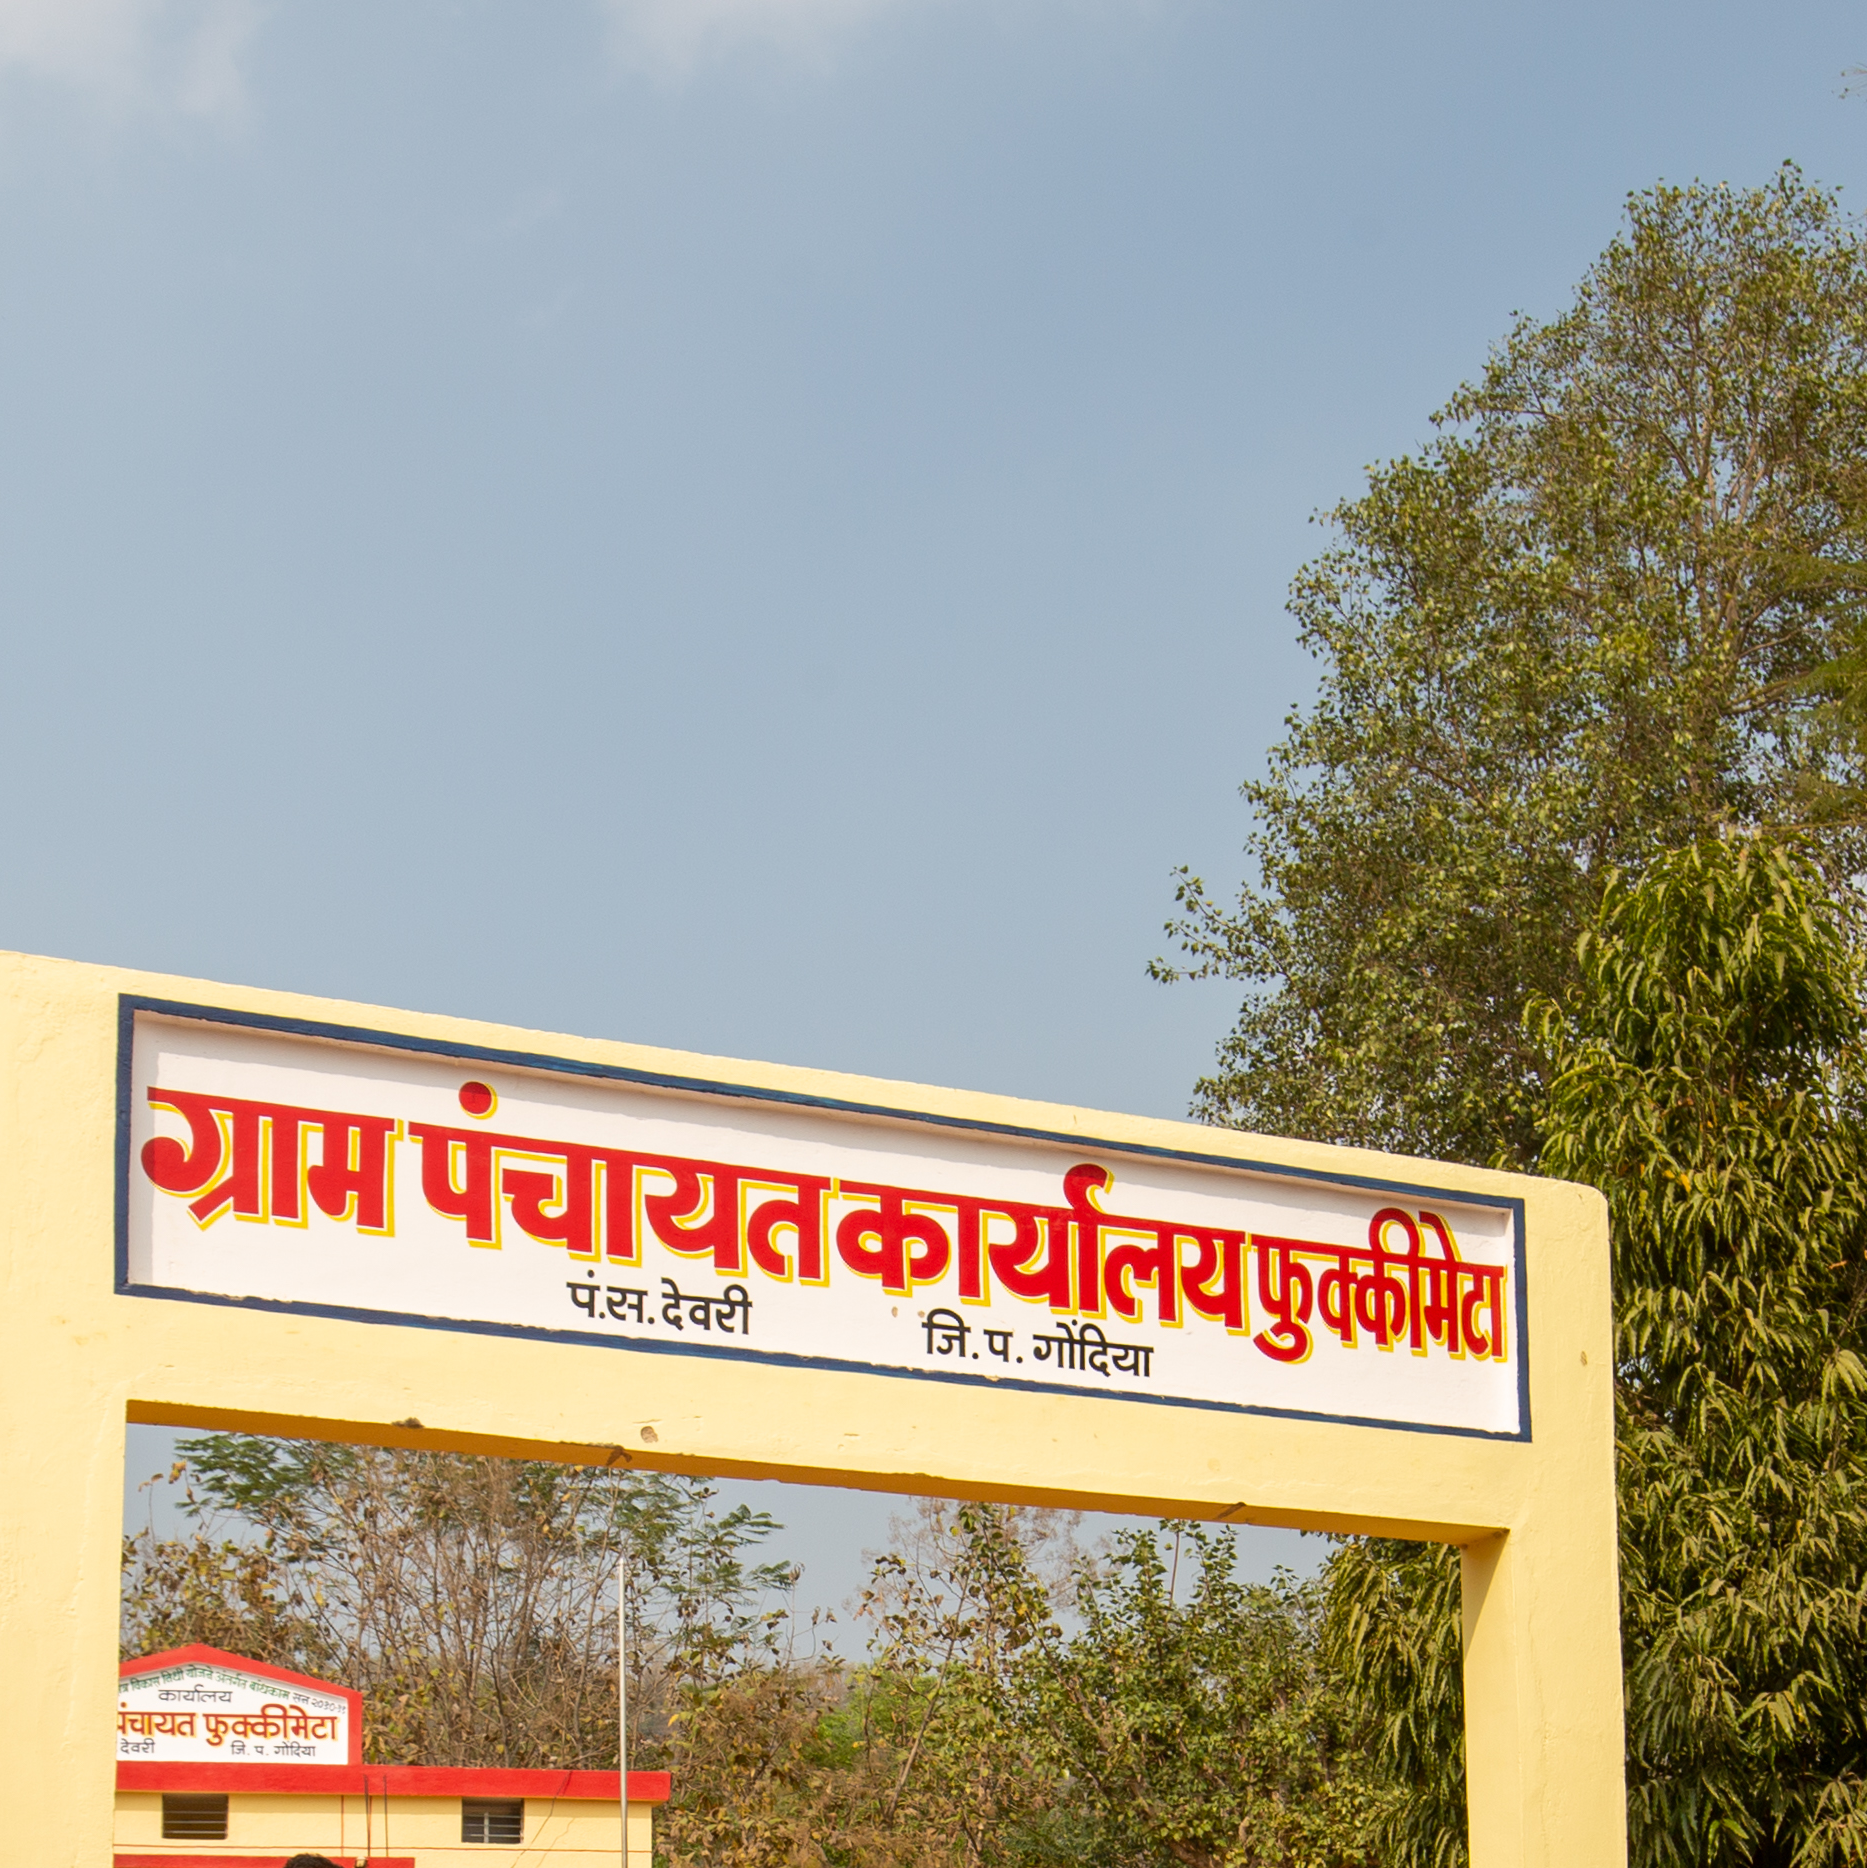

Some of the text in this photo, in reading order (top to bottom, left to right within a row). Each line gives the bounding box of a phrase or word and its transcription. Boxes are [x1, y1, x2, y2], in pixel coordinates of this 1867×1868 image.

[141, 1086, 403, 1238] ग्राम
[408, 1081, 840, 1287] पंचायत
[837, 1163, 1251, 1336] कार्यालय
[1033, 1319, 1154, 1377] गोंदिया
[158, 1684, 233, 1703] कार्यालय
[120, 1738, 155, 1754] देवरी
[274, 1741, 316, 1757] गोंदिया
